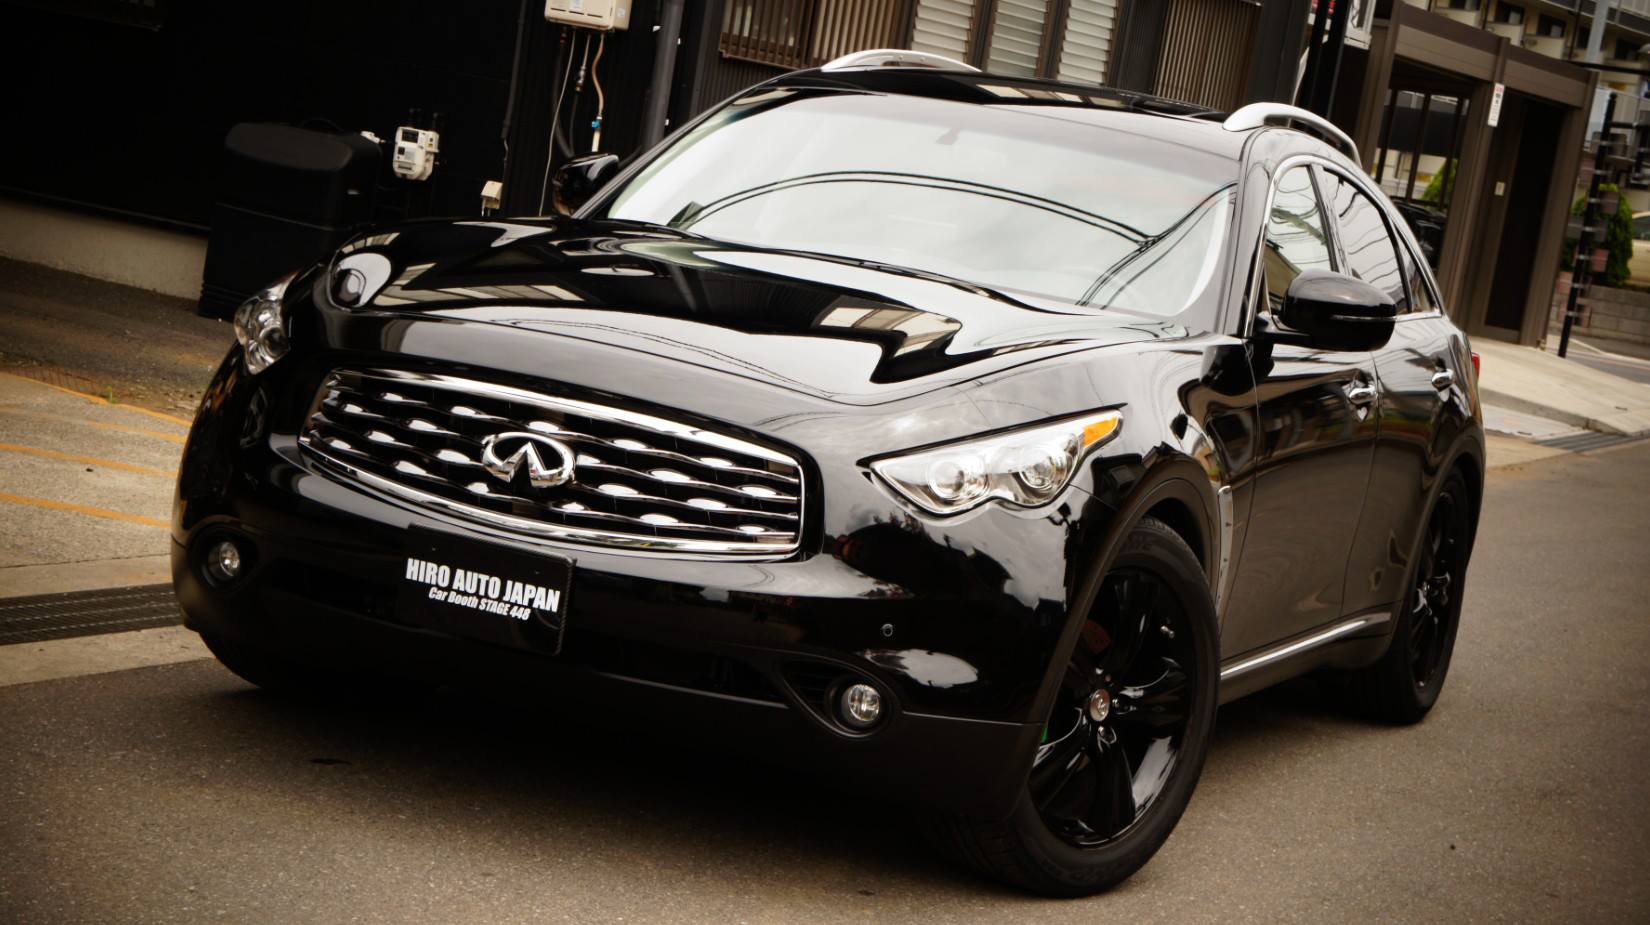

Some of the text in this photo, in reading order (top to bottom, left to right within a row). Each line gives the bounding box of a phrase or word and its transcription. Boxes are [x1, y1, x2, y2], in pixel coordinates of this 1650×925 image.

[405, 557, 561, 613] HIRO AUTO JAPAN
[428, 586, 532, 621] Car Booth STAGE 448
